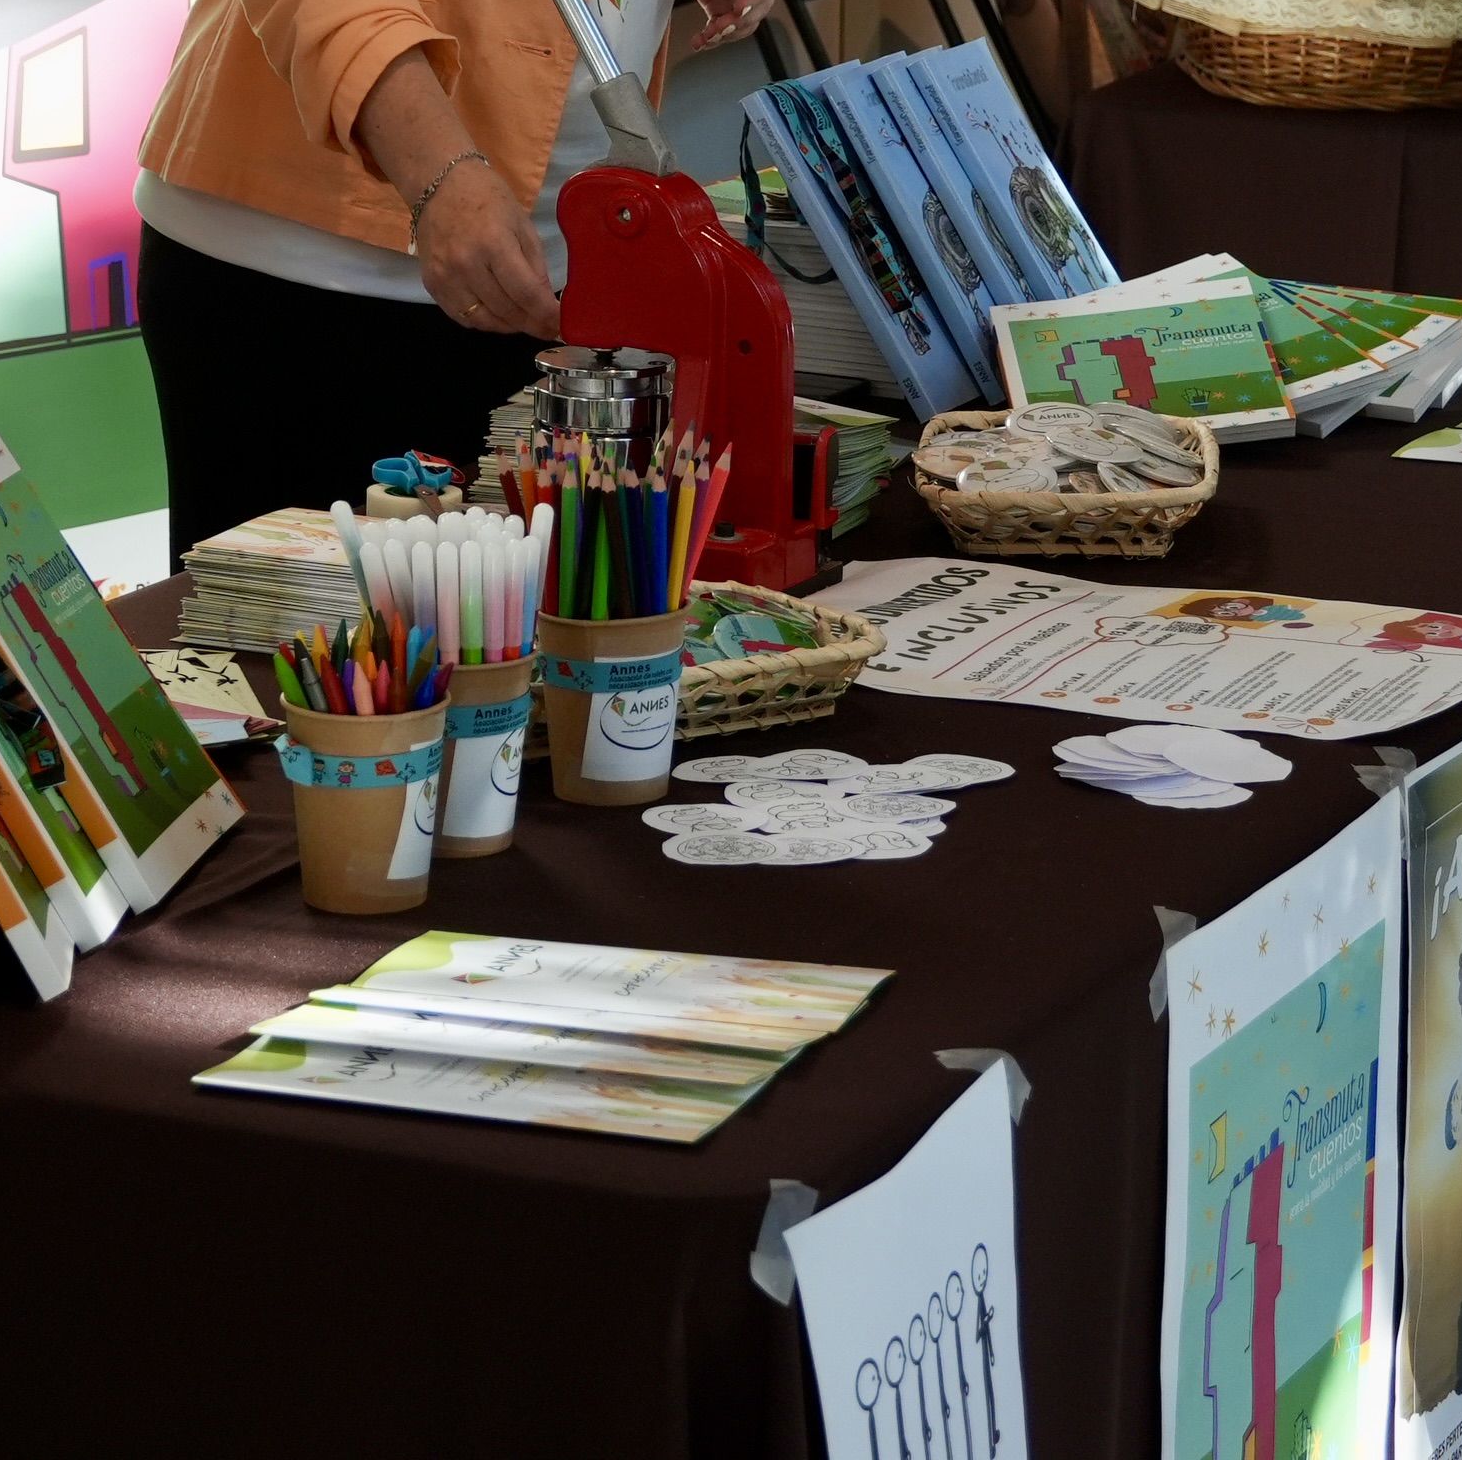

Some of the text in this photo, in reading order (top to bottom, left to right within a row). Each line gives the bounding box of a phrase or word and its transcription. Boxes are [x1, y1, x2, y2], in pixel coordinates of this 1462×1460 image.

[1134, 322, 1253, 347] Transmuta
[1181, 332, 1254, 346] cuentos
[963, 654, 1006, 683] Sábados
[1006, 641, 1027, 658] por
[1036, 620, 1072, 643] mañana
[609, 663, 651, 676] Annes
[474, 706, 512, 720] Annes
[629, 695, 669, 714] ANNES
[1282, 1072, 1365, 1189] Transmuta
[1308, 1115, 1363, 1180] cuentos
